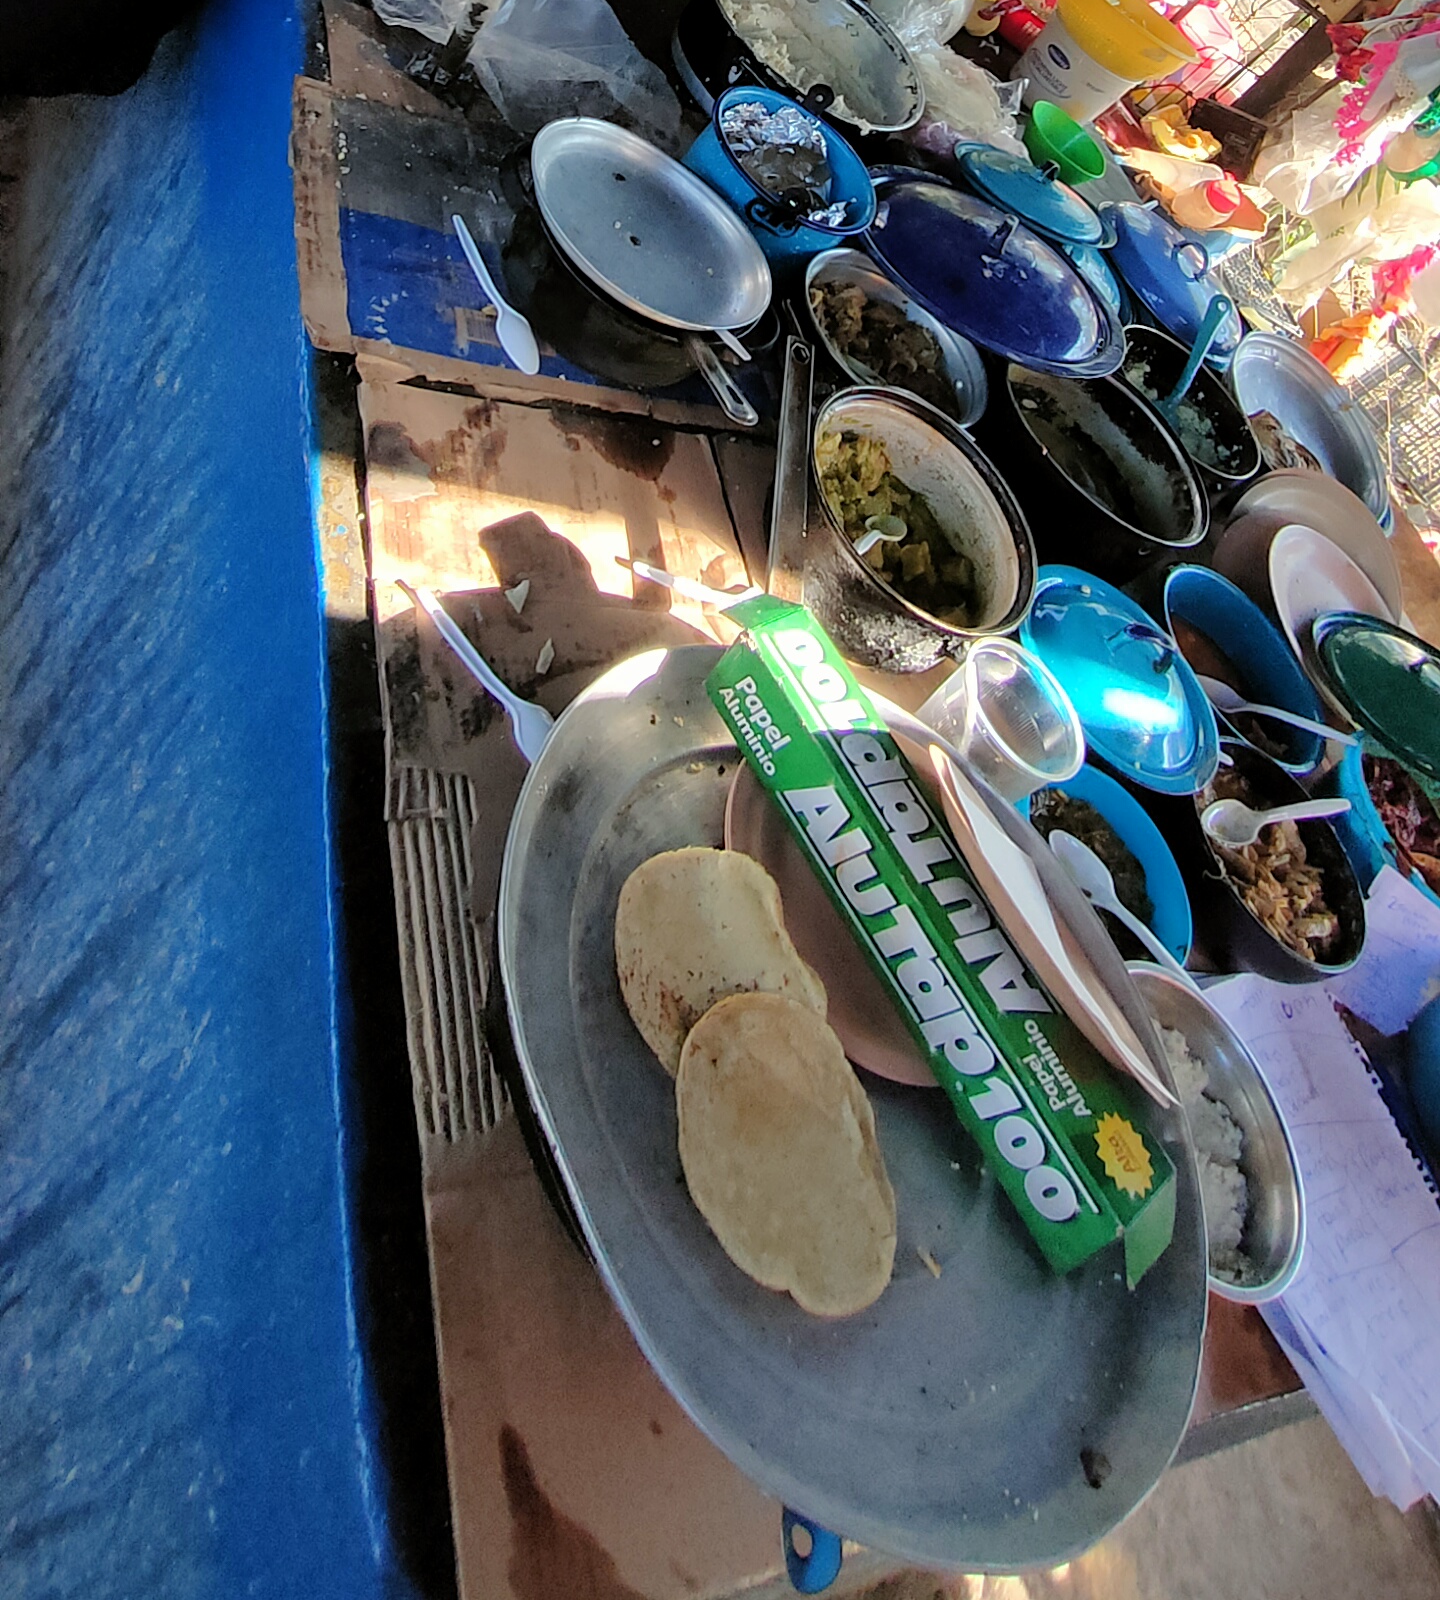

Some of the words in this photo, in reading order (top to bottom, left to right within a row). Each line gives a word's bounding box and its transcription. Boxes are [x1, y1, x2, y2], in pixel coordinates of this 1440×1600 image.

[719, 687, 776, 776] Aluminio
[735, 676, 791, 751] Papel
[1022, 1053, 1067, 1111] Papel
[1024, 1019, 1092, 1117] Aluminio
[1109, 1135, 1136, 1173] Alta
